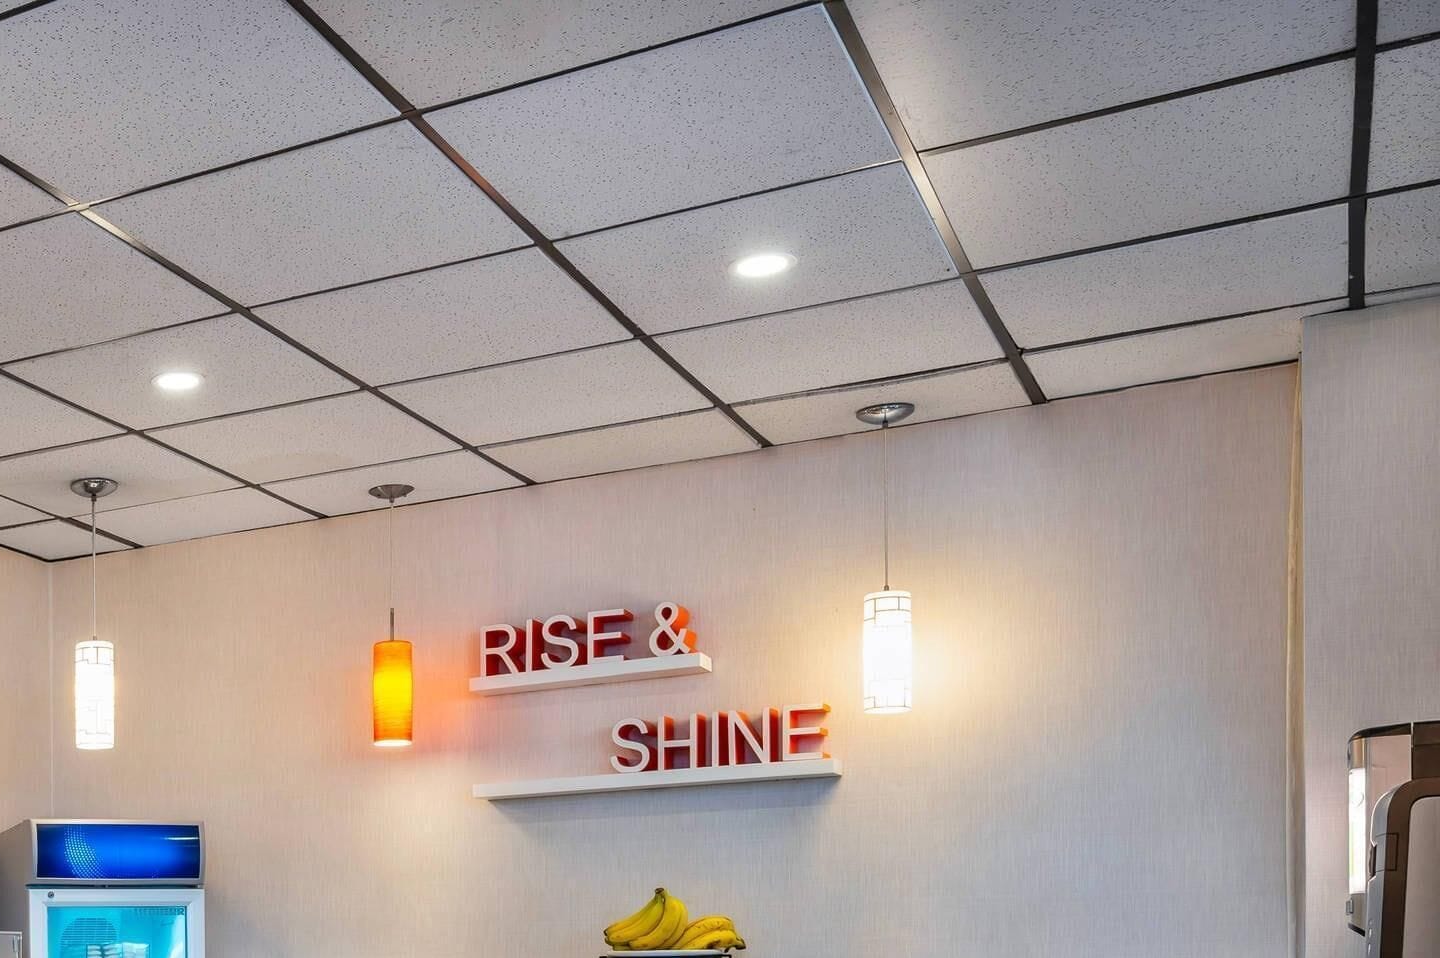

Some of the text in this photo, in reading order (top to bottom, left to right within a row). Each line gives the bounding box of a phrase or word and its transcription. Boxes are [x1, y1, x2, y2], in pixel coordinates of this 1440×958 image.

[479, 601, 696, 677] RISE &
[609, 703, 831, 774] SHINE
